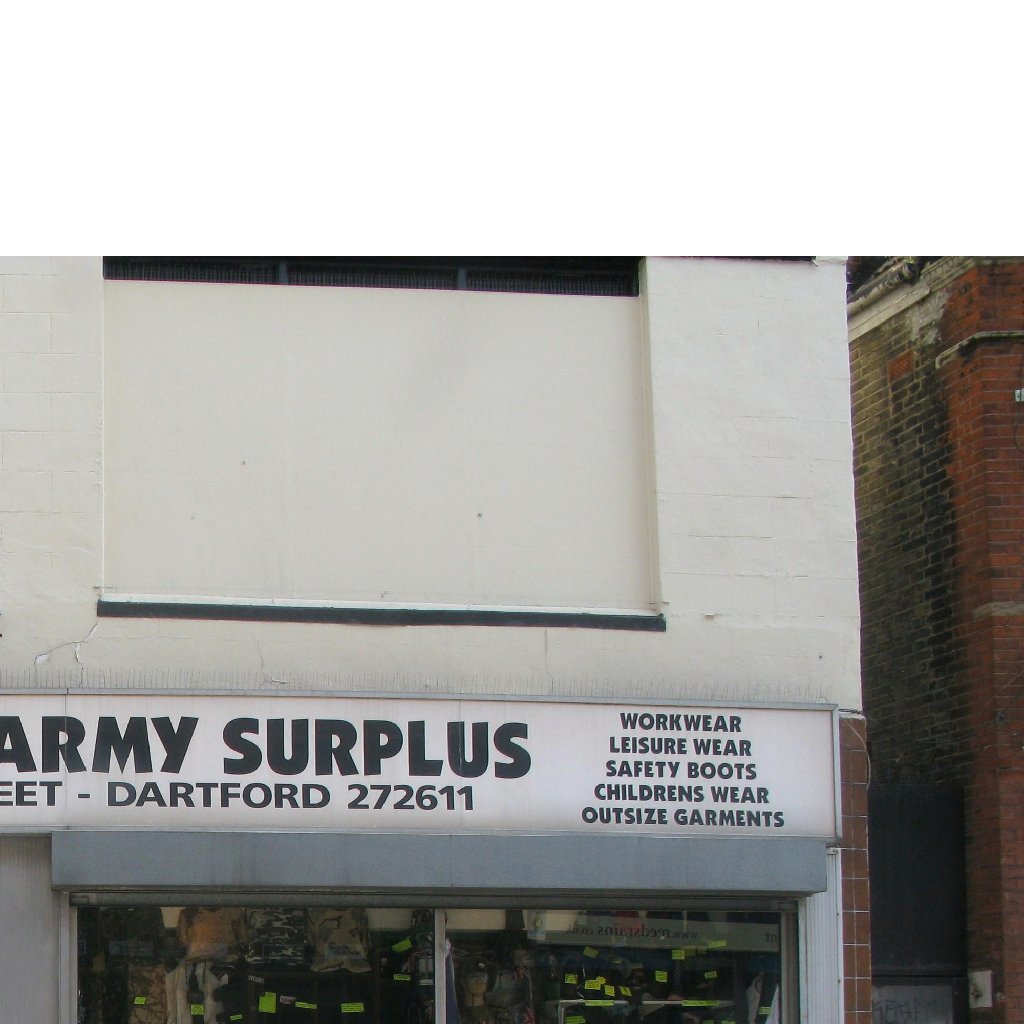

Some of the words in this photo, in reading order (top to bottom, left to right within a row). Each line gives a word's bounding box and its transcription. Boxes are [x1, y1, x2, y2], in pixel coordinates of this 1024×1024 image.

[620, 712, 742, 733] WORKWEAR
[223, 718, 531, 779] SURPLUS
[609, 736, 688, 755] LEISURE
[693, 739, 752, 757] WEAR
[605, 760, 681, 779] SAFETY
[687, 762, 757, 781] BOOTS
[107, 781, 331, 810] DARTFORD
[347, 783, 474, 812] 272611
[594, 783, 705, 803] CHILDRENS
[711, 786, 770, 804] WEAR
[581, 806, 668, 825] OUTSIZE
[673, 808, 785, 828] GARMENTS
